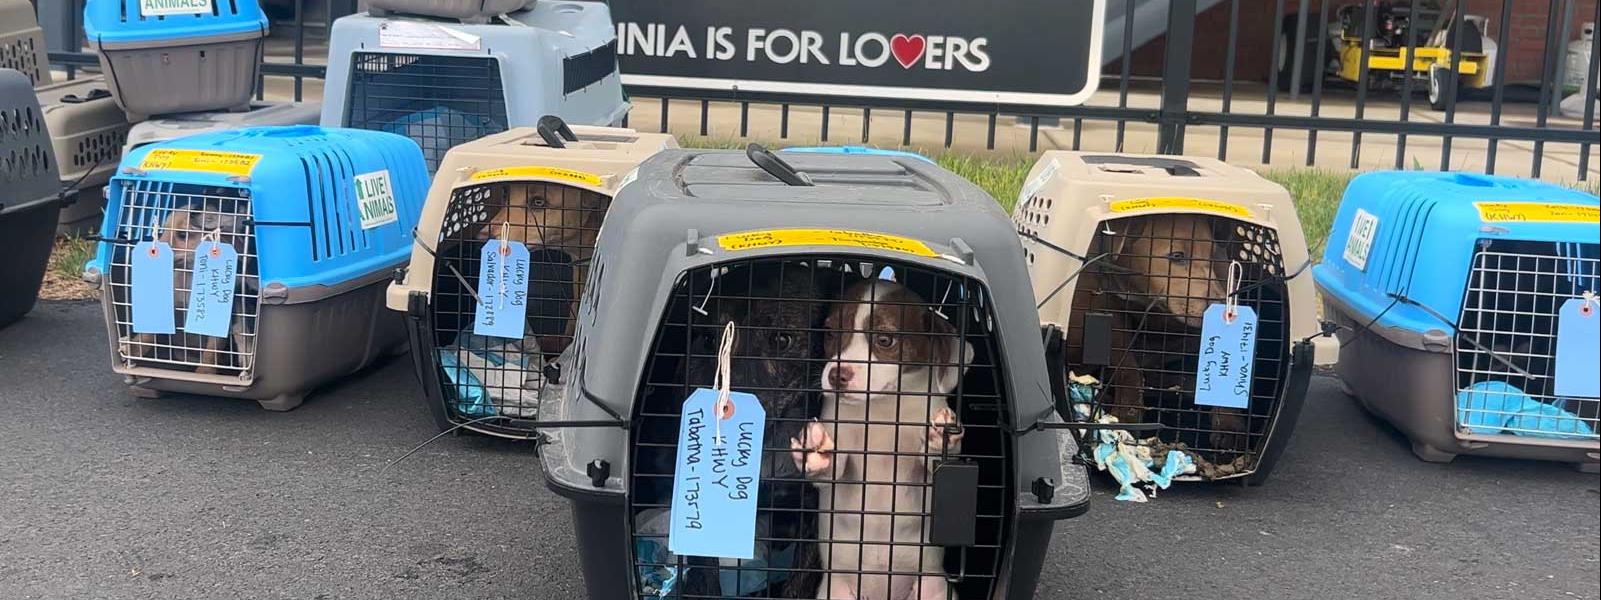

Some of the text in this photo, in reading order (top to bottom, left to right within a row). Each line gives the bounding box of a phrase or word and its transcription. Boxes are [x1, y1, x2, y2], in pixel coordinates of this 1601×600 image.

[706, 26, 735, 60] IS
[746, 28, 830, 65] FOR
[511, 259, 527, 306] Lucky Dog
[1199, 335, 1221, 392] Lucky Dog
[1218, 350, 1231, 377] KHWY
[728, 422, 754, 501] Lucky Dog
